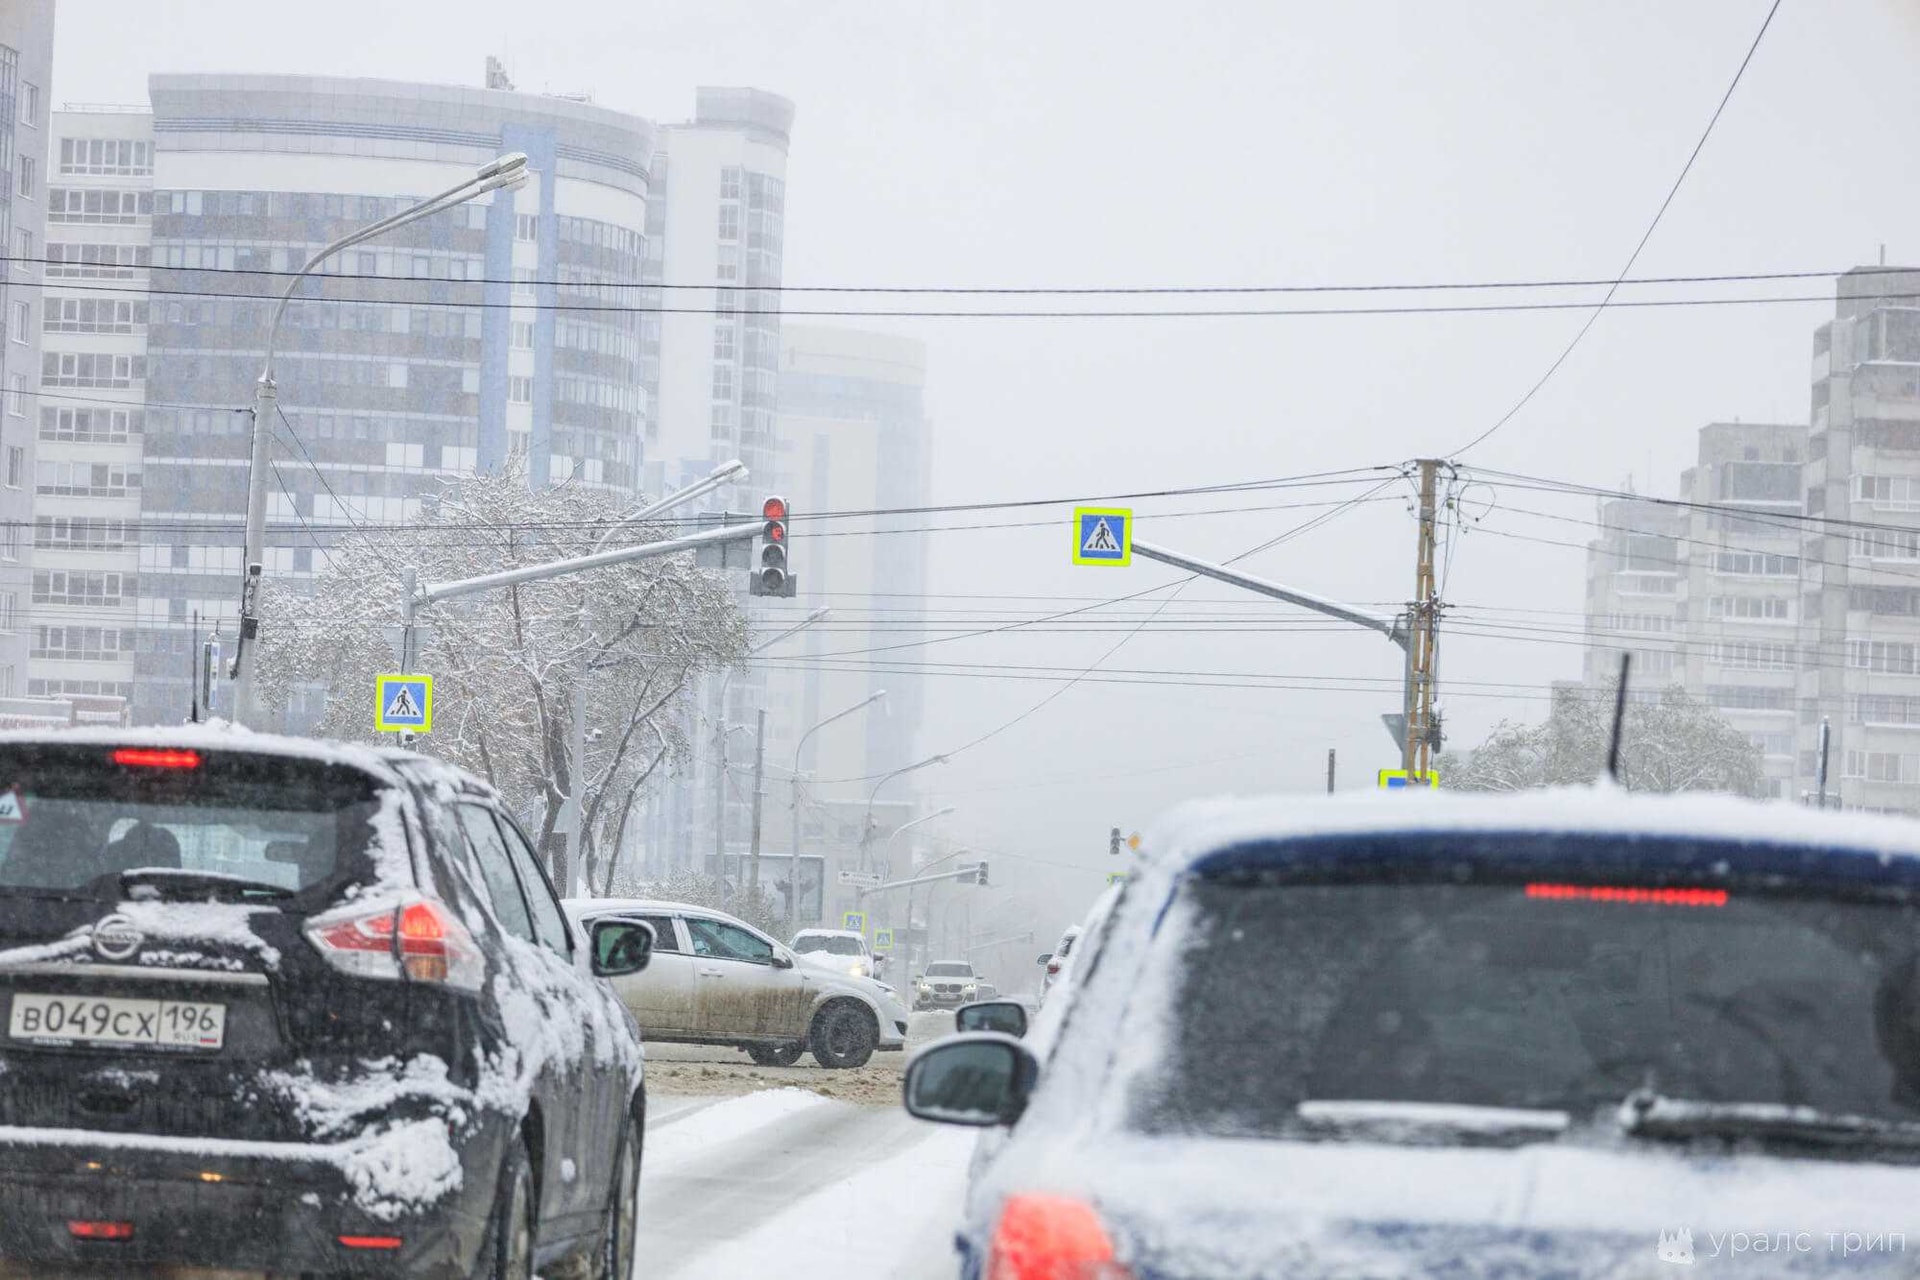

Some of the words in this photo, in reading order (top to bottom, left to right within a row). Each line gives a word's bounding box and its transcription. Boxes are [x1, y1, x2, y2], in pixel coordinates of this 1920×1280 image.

[22, 1001, 156, 1037] В049СХ
[165, 1005, 217, 1031] 196
[173, 1032, 199, 1042] RUS
